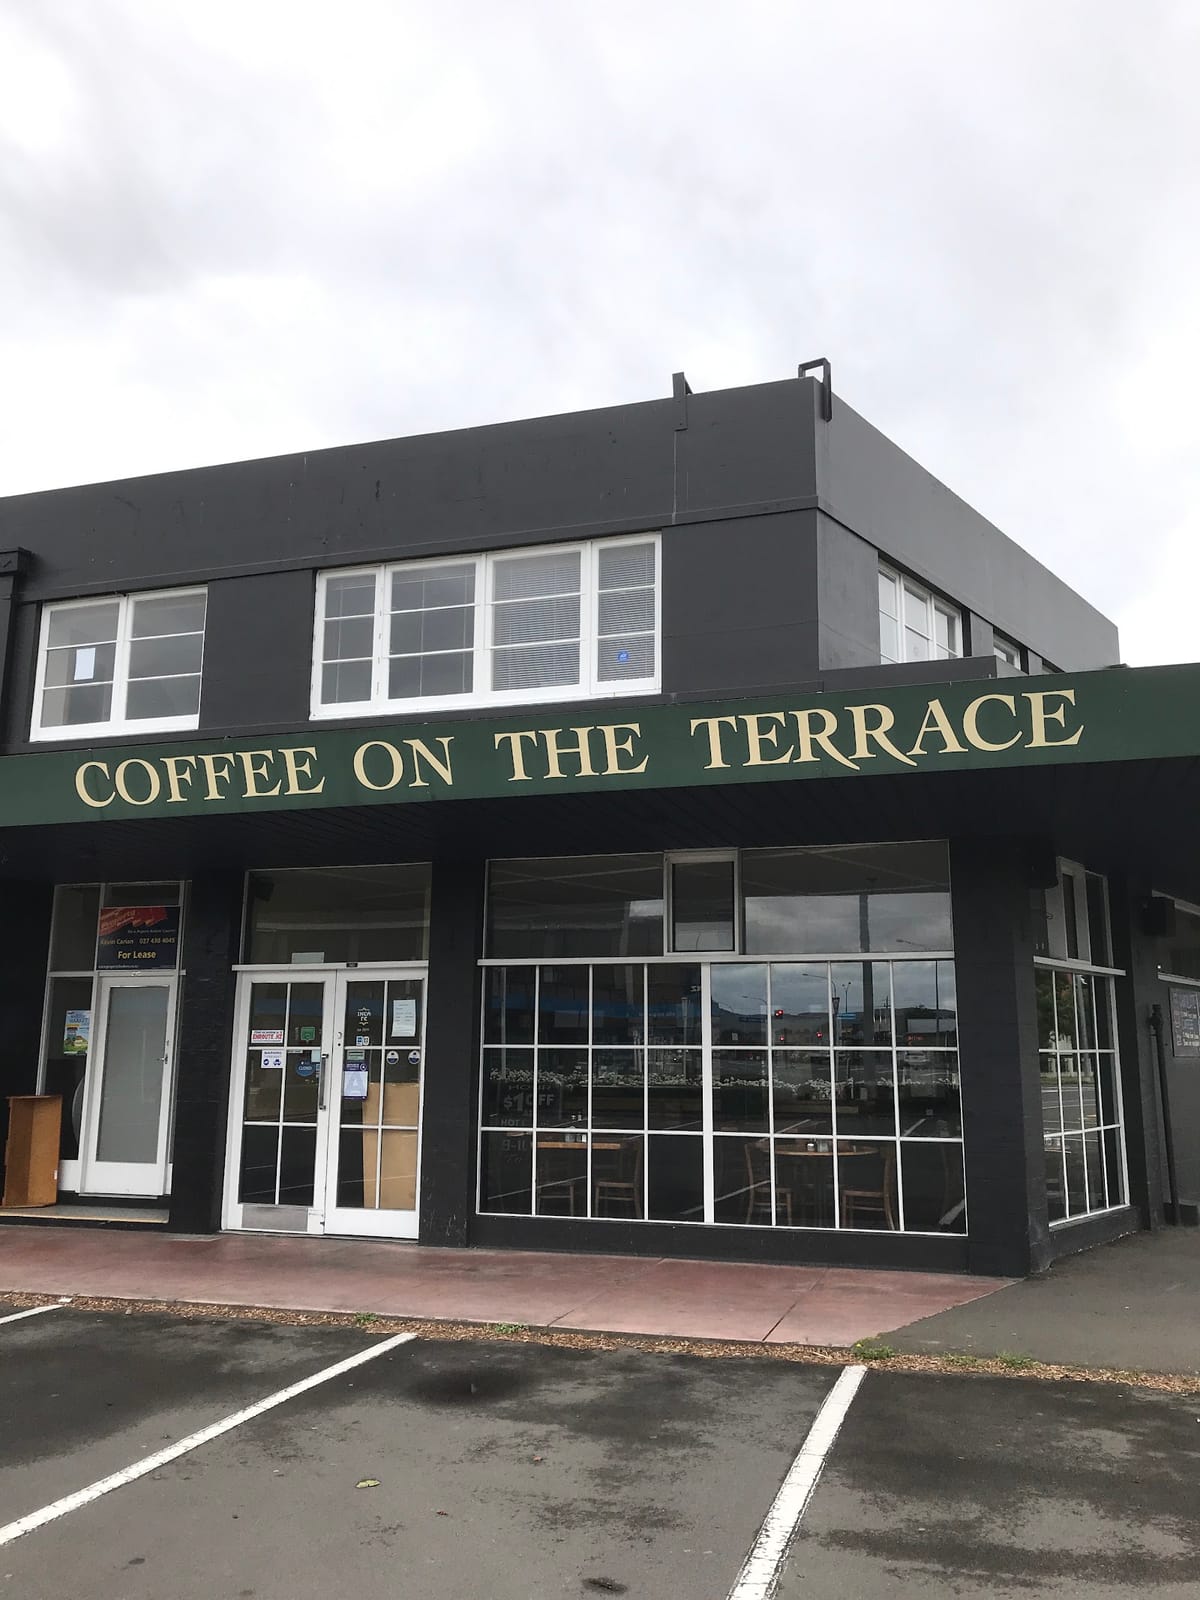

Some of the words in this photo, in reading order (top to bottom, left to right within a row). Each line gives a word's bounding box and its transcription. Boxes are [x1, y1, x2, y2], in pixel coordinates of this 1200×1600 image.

[75, 747, 325, 808] COFFEE
[353, 736, 455, 791] ON
[494, 723, 648, 781] THE
[690, 689, 1084, 771] TERRACE
[118, 951, 132, 959] For
[133, 951, 157, 959] Lease
